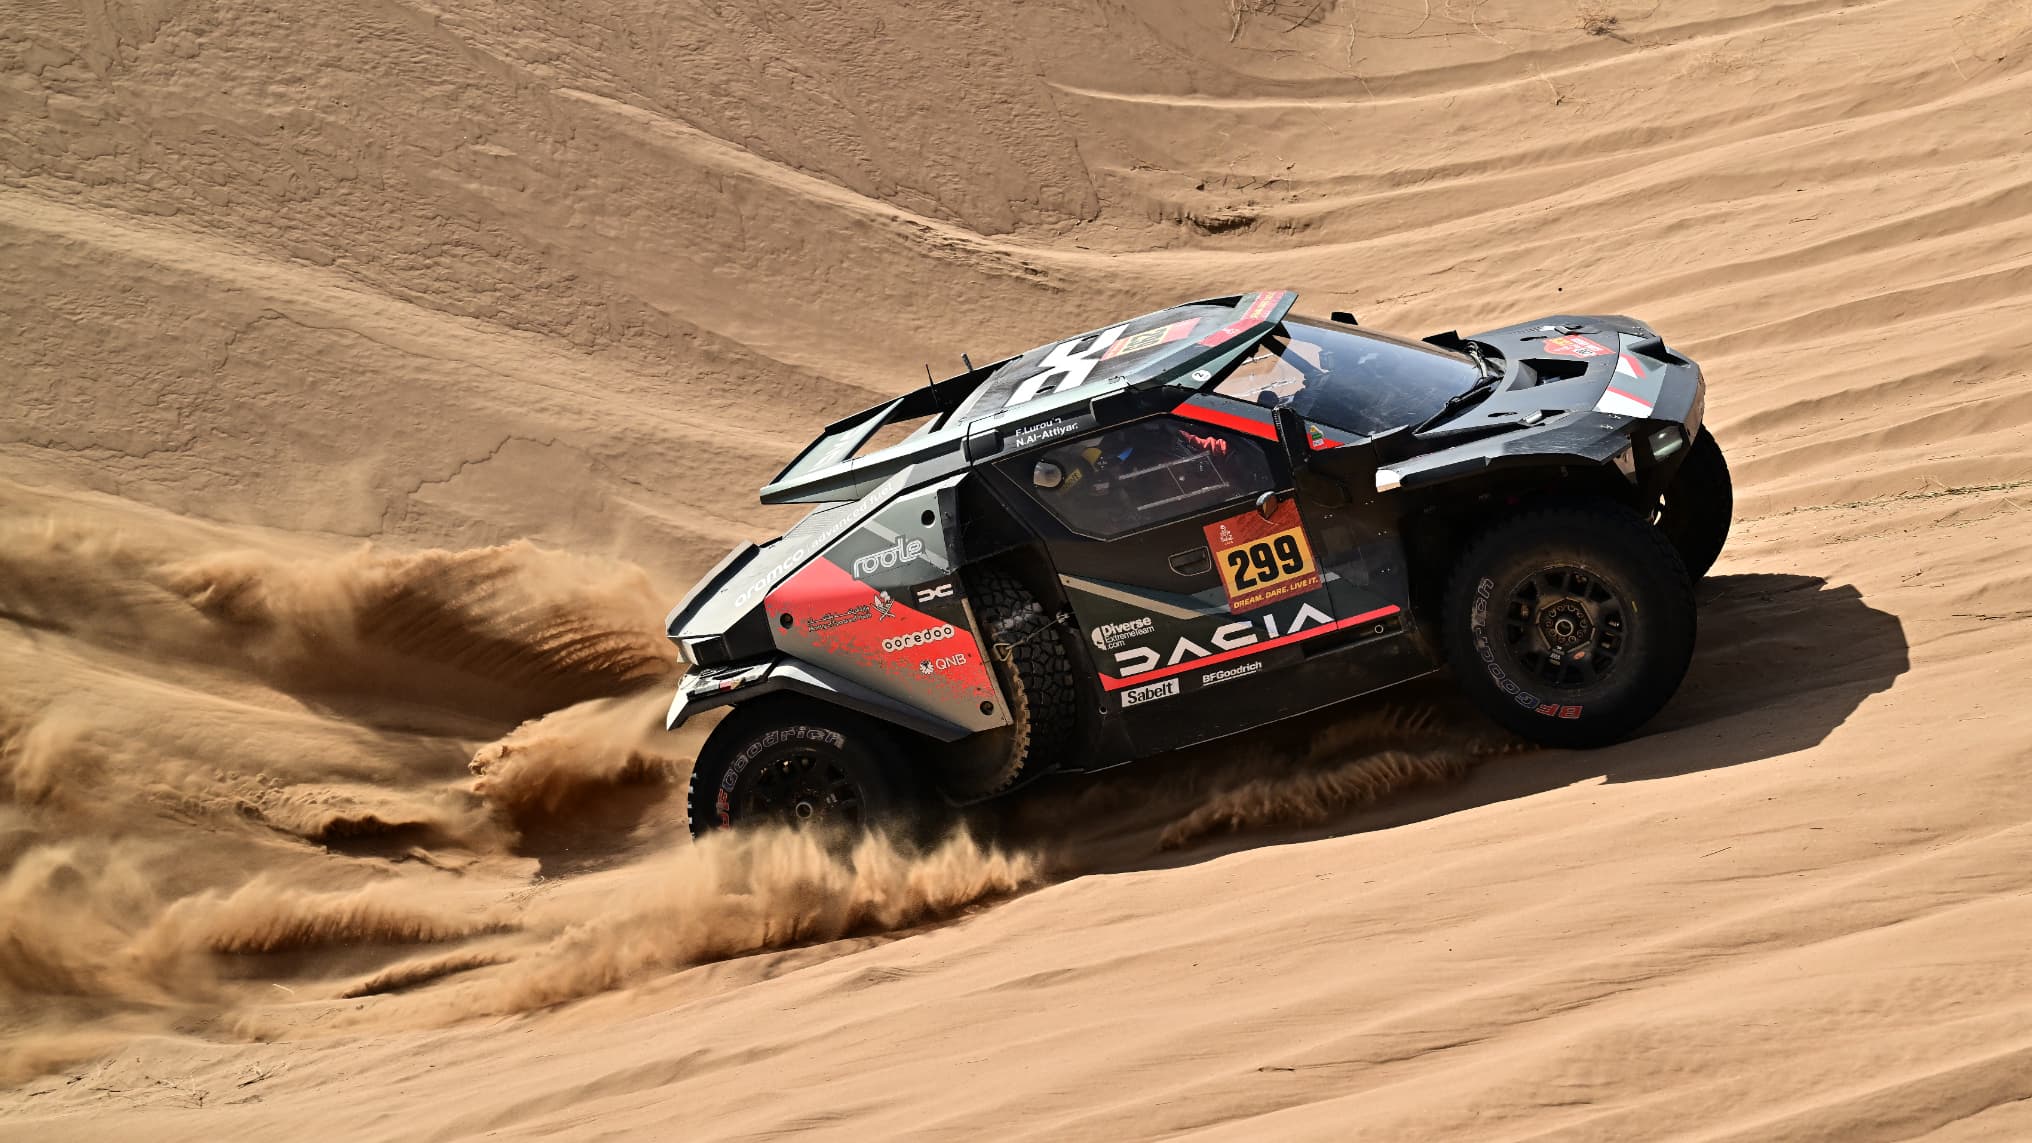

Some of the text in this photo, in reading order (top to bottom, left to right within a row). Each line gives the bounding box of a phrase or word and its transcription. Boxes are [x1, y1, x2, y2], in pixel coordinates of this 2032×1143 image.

[735, 549, 804, 608] aramco
[811, 502, 867, 546] advanced
[1227, 534, 1304, 591] 299
[1233, 594, 1265, 609] DREAM.
[1265, 585, 1289, 598] DARE.
[1290, 580, 1308, 591] LIVE
[883, 625, 954, 651] ooredoo
[1101, 617, 1152, 637] Diverse
[1114, 602, 1335, 677] DACIA
[935, 653, 967, 670] QNB
[1471, 577, 1583, 719] BFGoodrch
[1202, 661, 1262, 682] BFGoodrich
[1127, 682, 1174, 704] Sabelt
